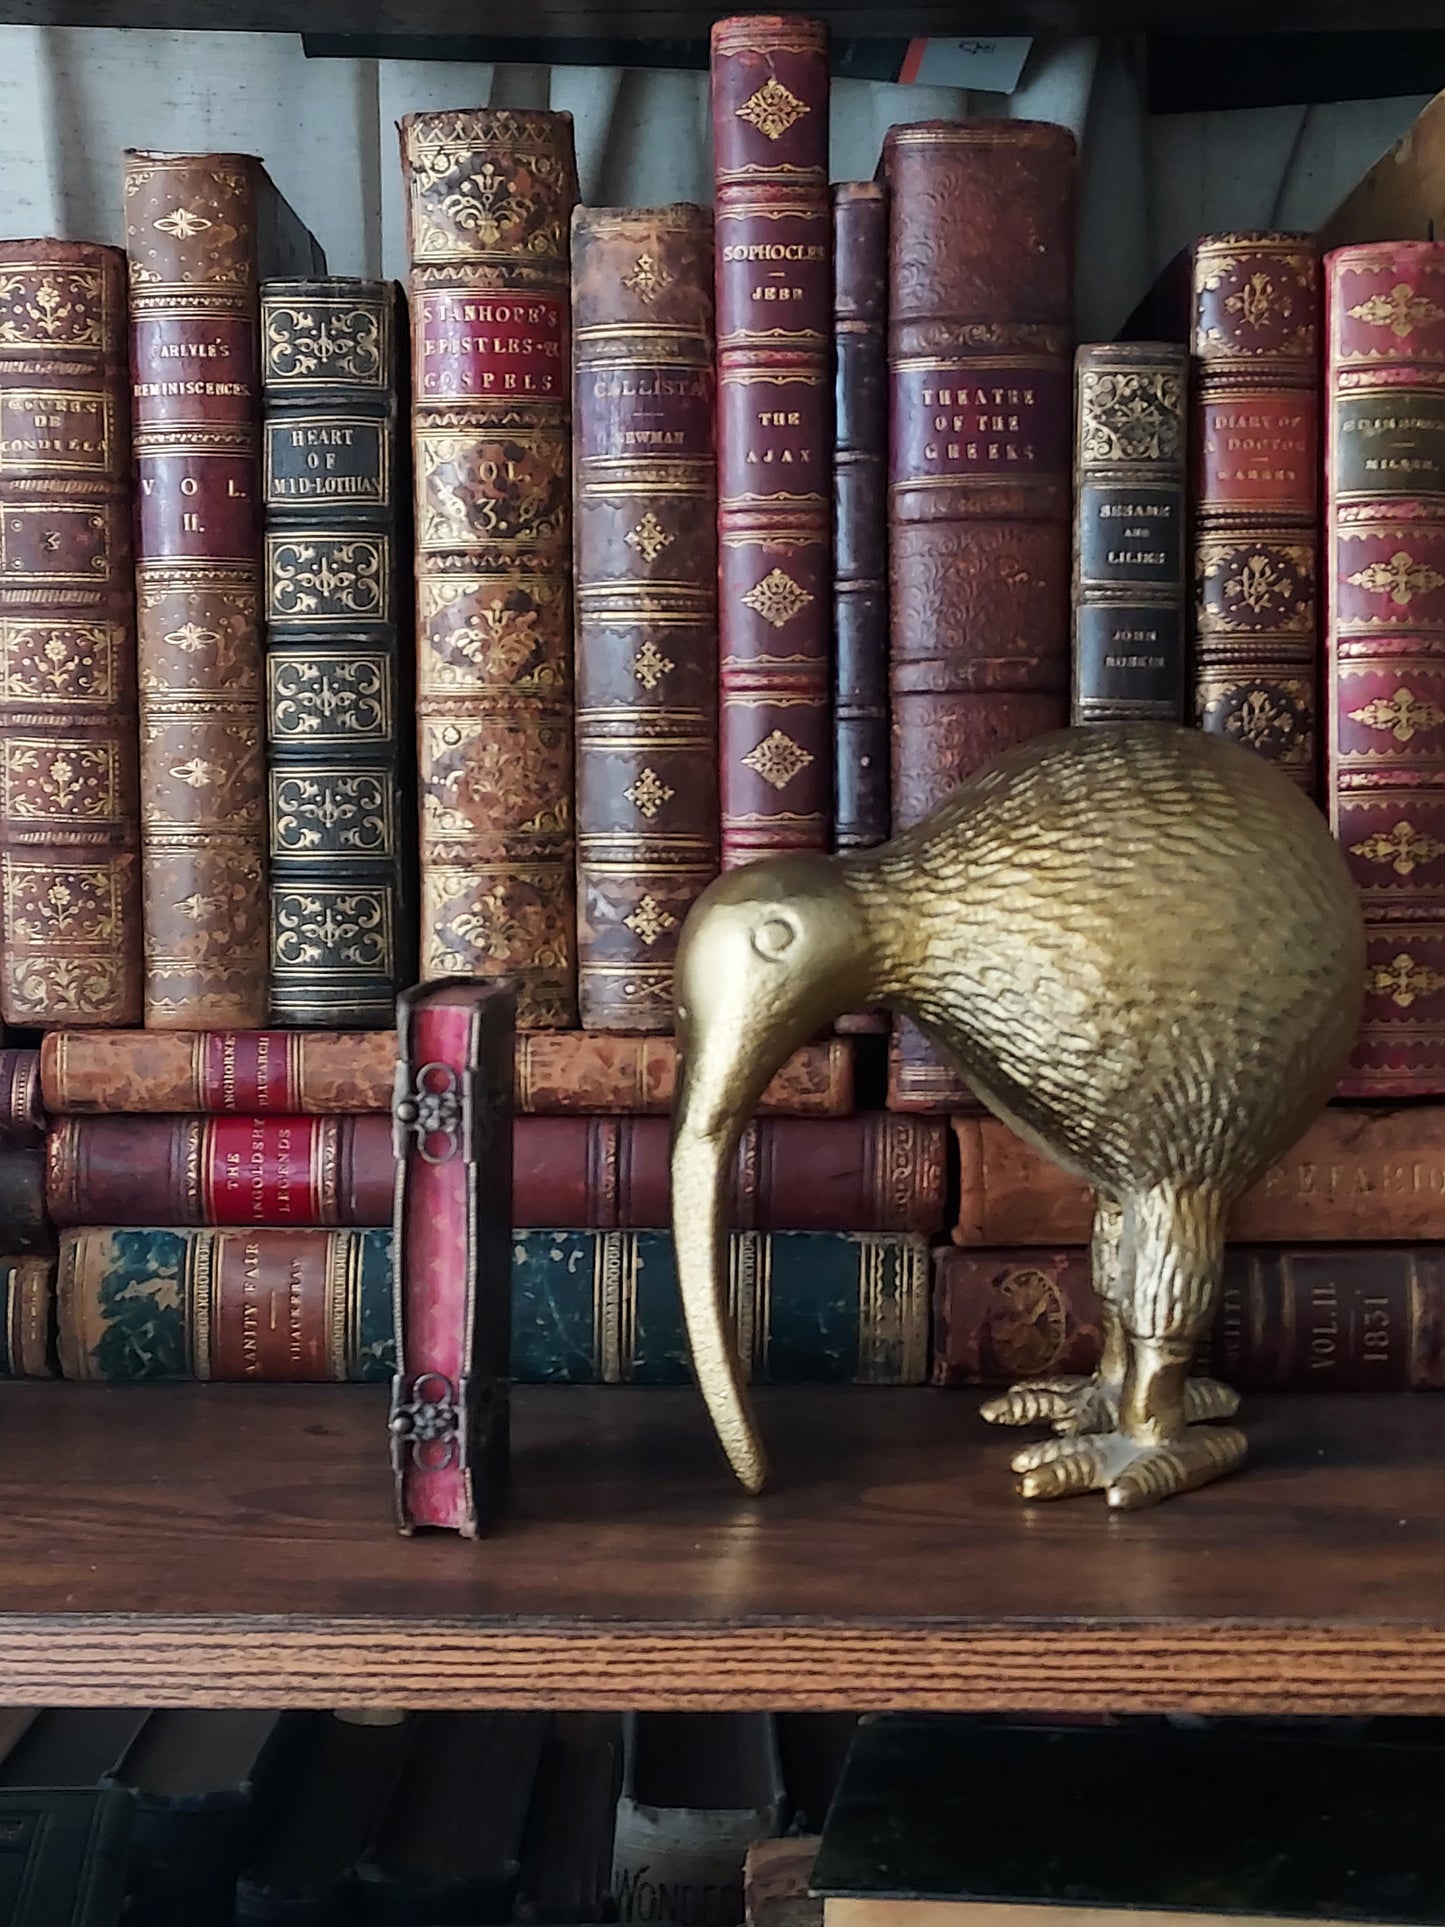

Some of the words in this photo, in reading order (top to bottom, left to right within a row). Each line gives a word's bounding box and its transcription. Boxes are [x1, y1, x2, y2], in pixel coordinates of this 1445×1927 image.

[723, 244, 825, 261] SOPHOCLES
[752, 286, 803, 301] JEBB
[151, 337, 230, 358] CARLYLE'S
[424, 372, 553, 391] GOSPELS
[921, 389, 1035, 406] THEATRE
[34, 415, 63, 428] DE
[758, 412, 801, 426] THE
[935, 415, 964, 431] OF
[977, 415, 1020, 431] THE
[291, 429, 354, 446] HEART
[307, 452, 336, 470] OF
[746, 449, 811, 463] AJAX
[274, 476, 381, 494] MID-LOTHIAN
[183, 513, 206, 533] II.
[474, 498, 508, 531] 3.
[227, 1153, 240, 1191] THE
[277, 1128, 292, 1213] LEGENDS
[243, 1243, 260, 1293] FAIR
